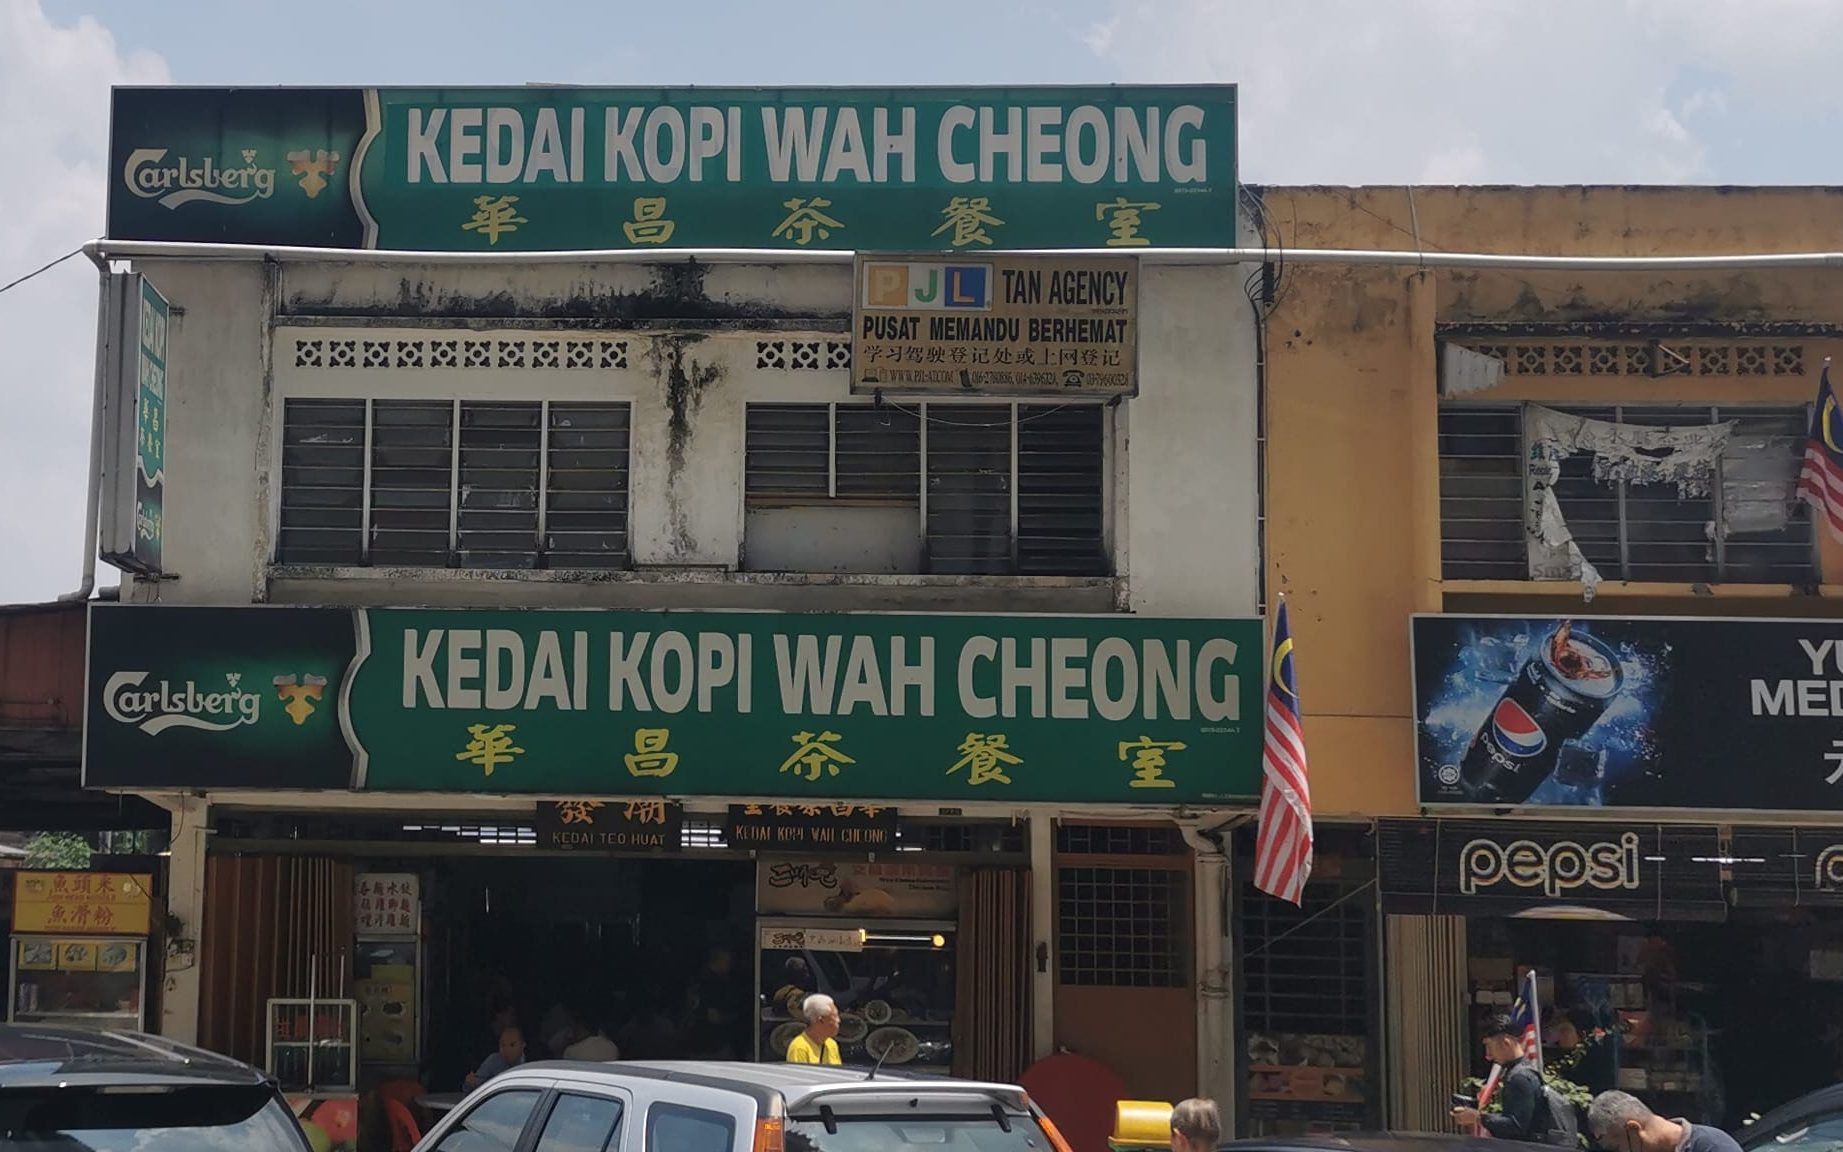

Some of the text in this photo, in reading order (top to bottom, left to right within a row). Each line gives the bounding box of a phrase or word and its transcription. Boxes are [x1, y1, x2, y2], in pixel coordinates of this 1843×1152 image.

[406, 104, 1208, 185] KEDAI KOPI WAH CHEONG
[124, 147, 275, 208] Carlsberg
[1002, 269, 1129, 306] TAN AGENCY
[862, 315, 1128, 344] PUSAT MEMANDU BERHEMAT
[402, 628, 1240, 721] KEDAI KOPI WAH CHEONG
[103, 670, 261, 735] Carlsberg
[1480, 731, 1522, 774] pepsi
[552, 831, 666, 846] KEDAI TEO HUAT
[735, 824, 771, 841] KEDAI
[777, 825, 804, 842] KOPI
[1459, 831, 1640, 897] pepsi
